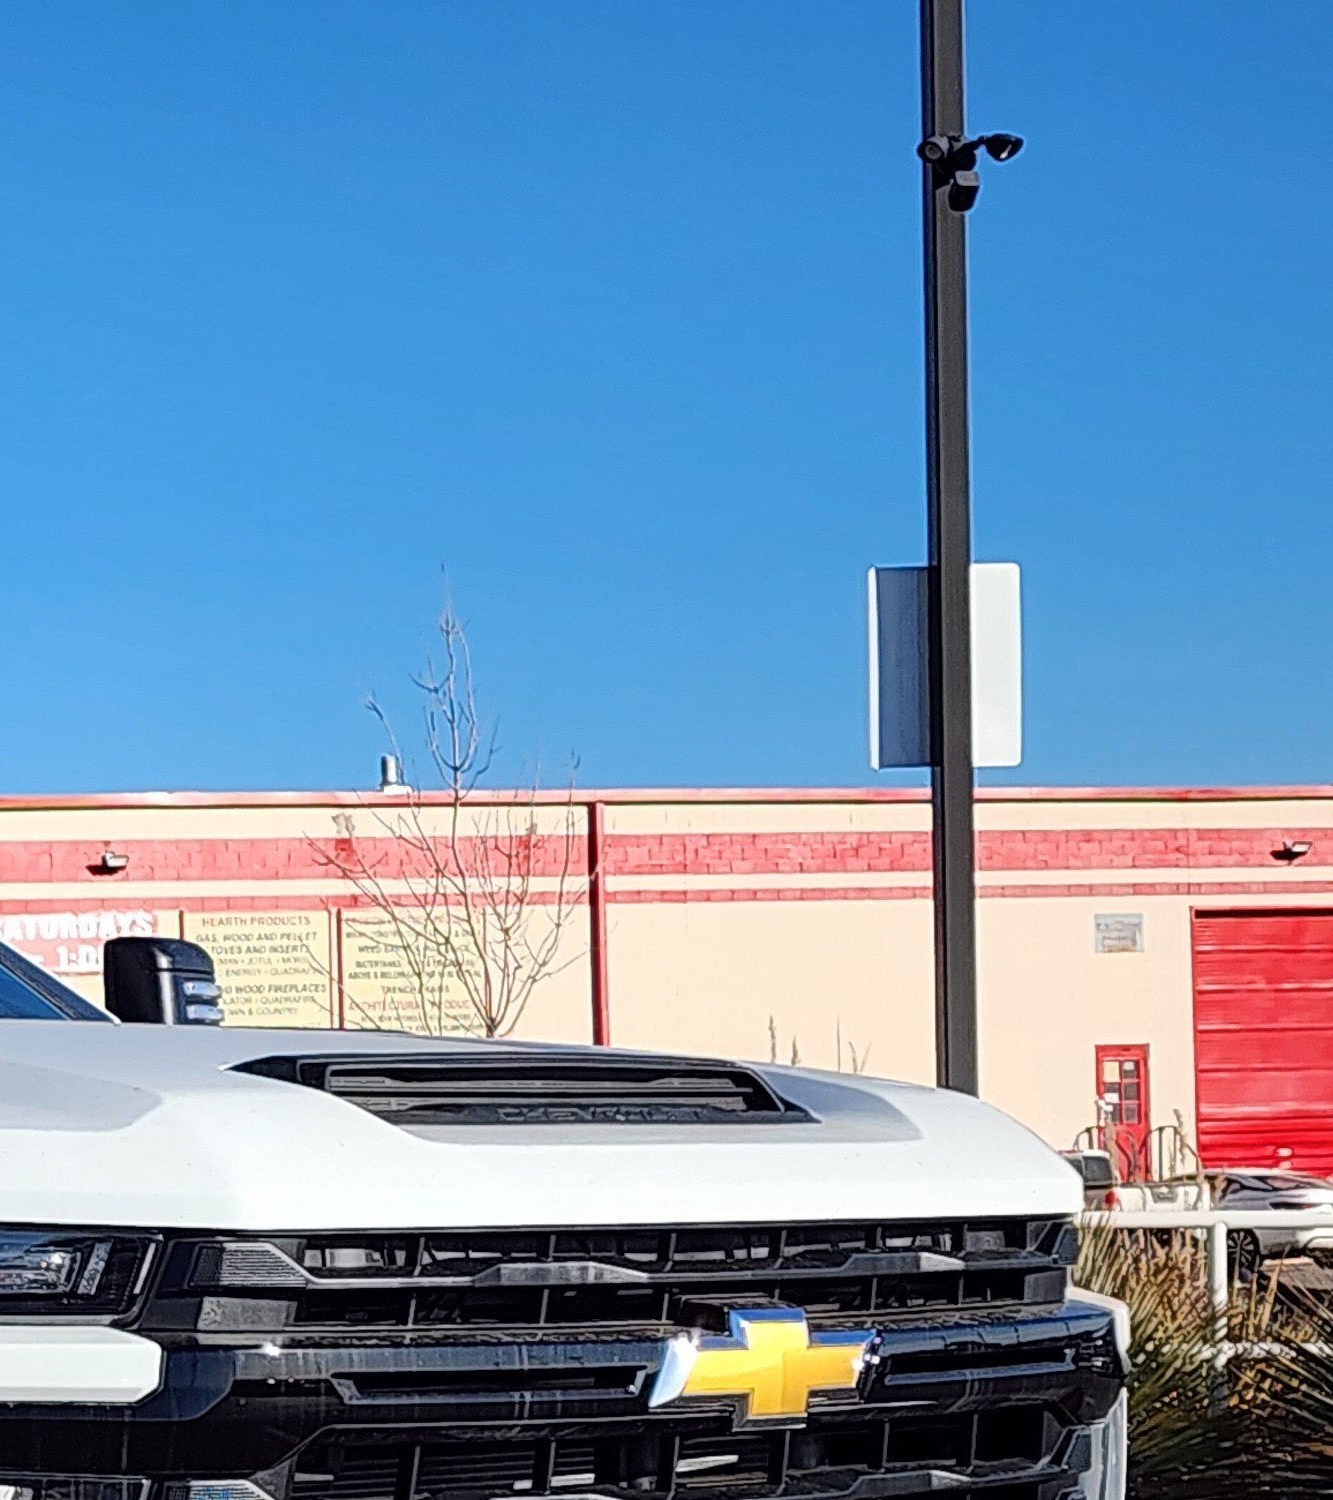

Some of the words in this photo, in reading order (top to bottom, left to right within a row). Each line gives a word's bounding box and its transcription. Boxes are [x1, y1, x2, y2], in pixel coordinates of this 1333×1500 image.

[201, 916, 247, 927] HEARTH
[250, 915, 311, 926] PRODUCTS
[223, 932, 254, 942] WOOD
[256, 932, 278, 942] AND
[206, 945, 243, 955] TOVES
[245, 945, 266, 955] AND
[268, 944, 311, 954] INSERTS
[235, 984, 265, 994] WOOD
[268, 983, 326, 993] FIREPLACES
